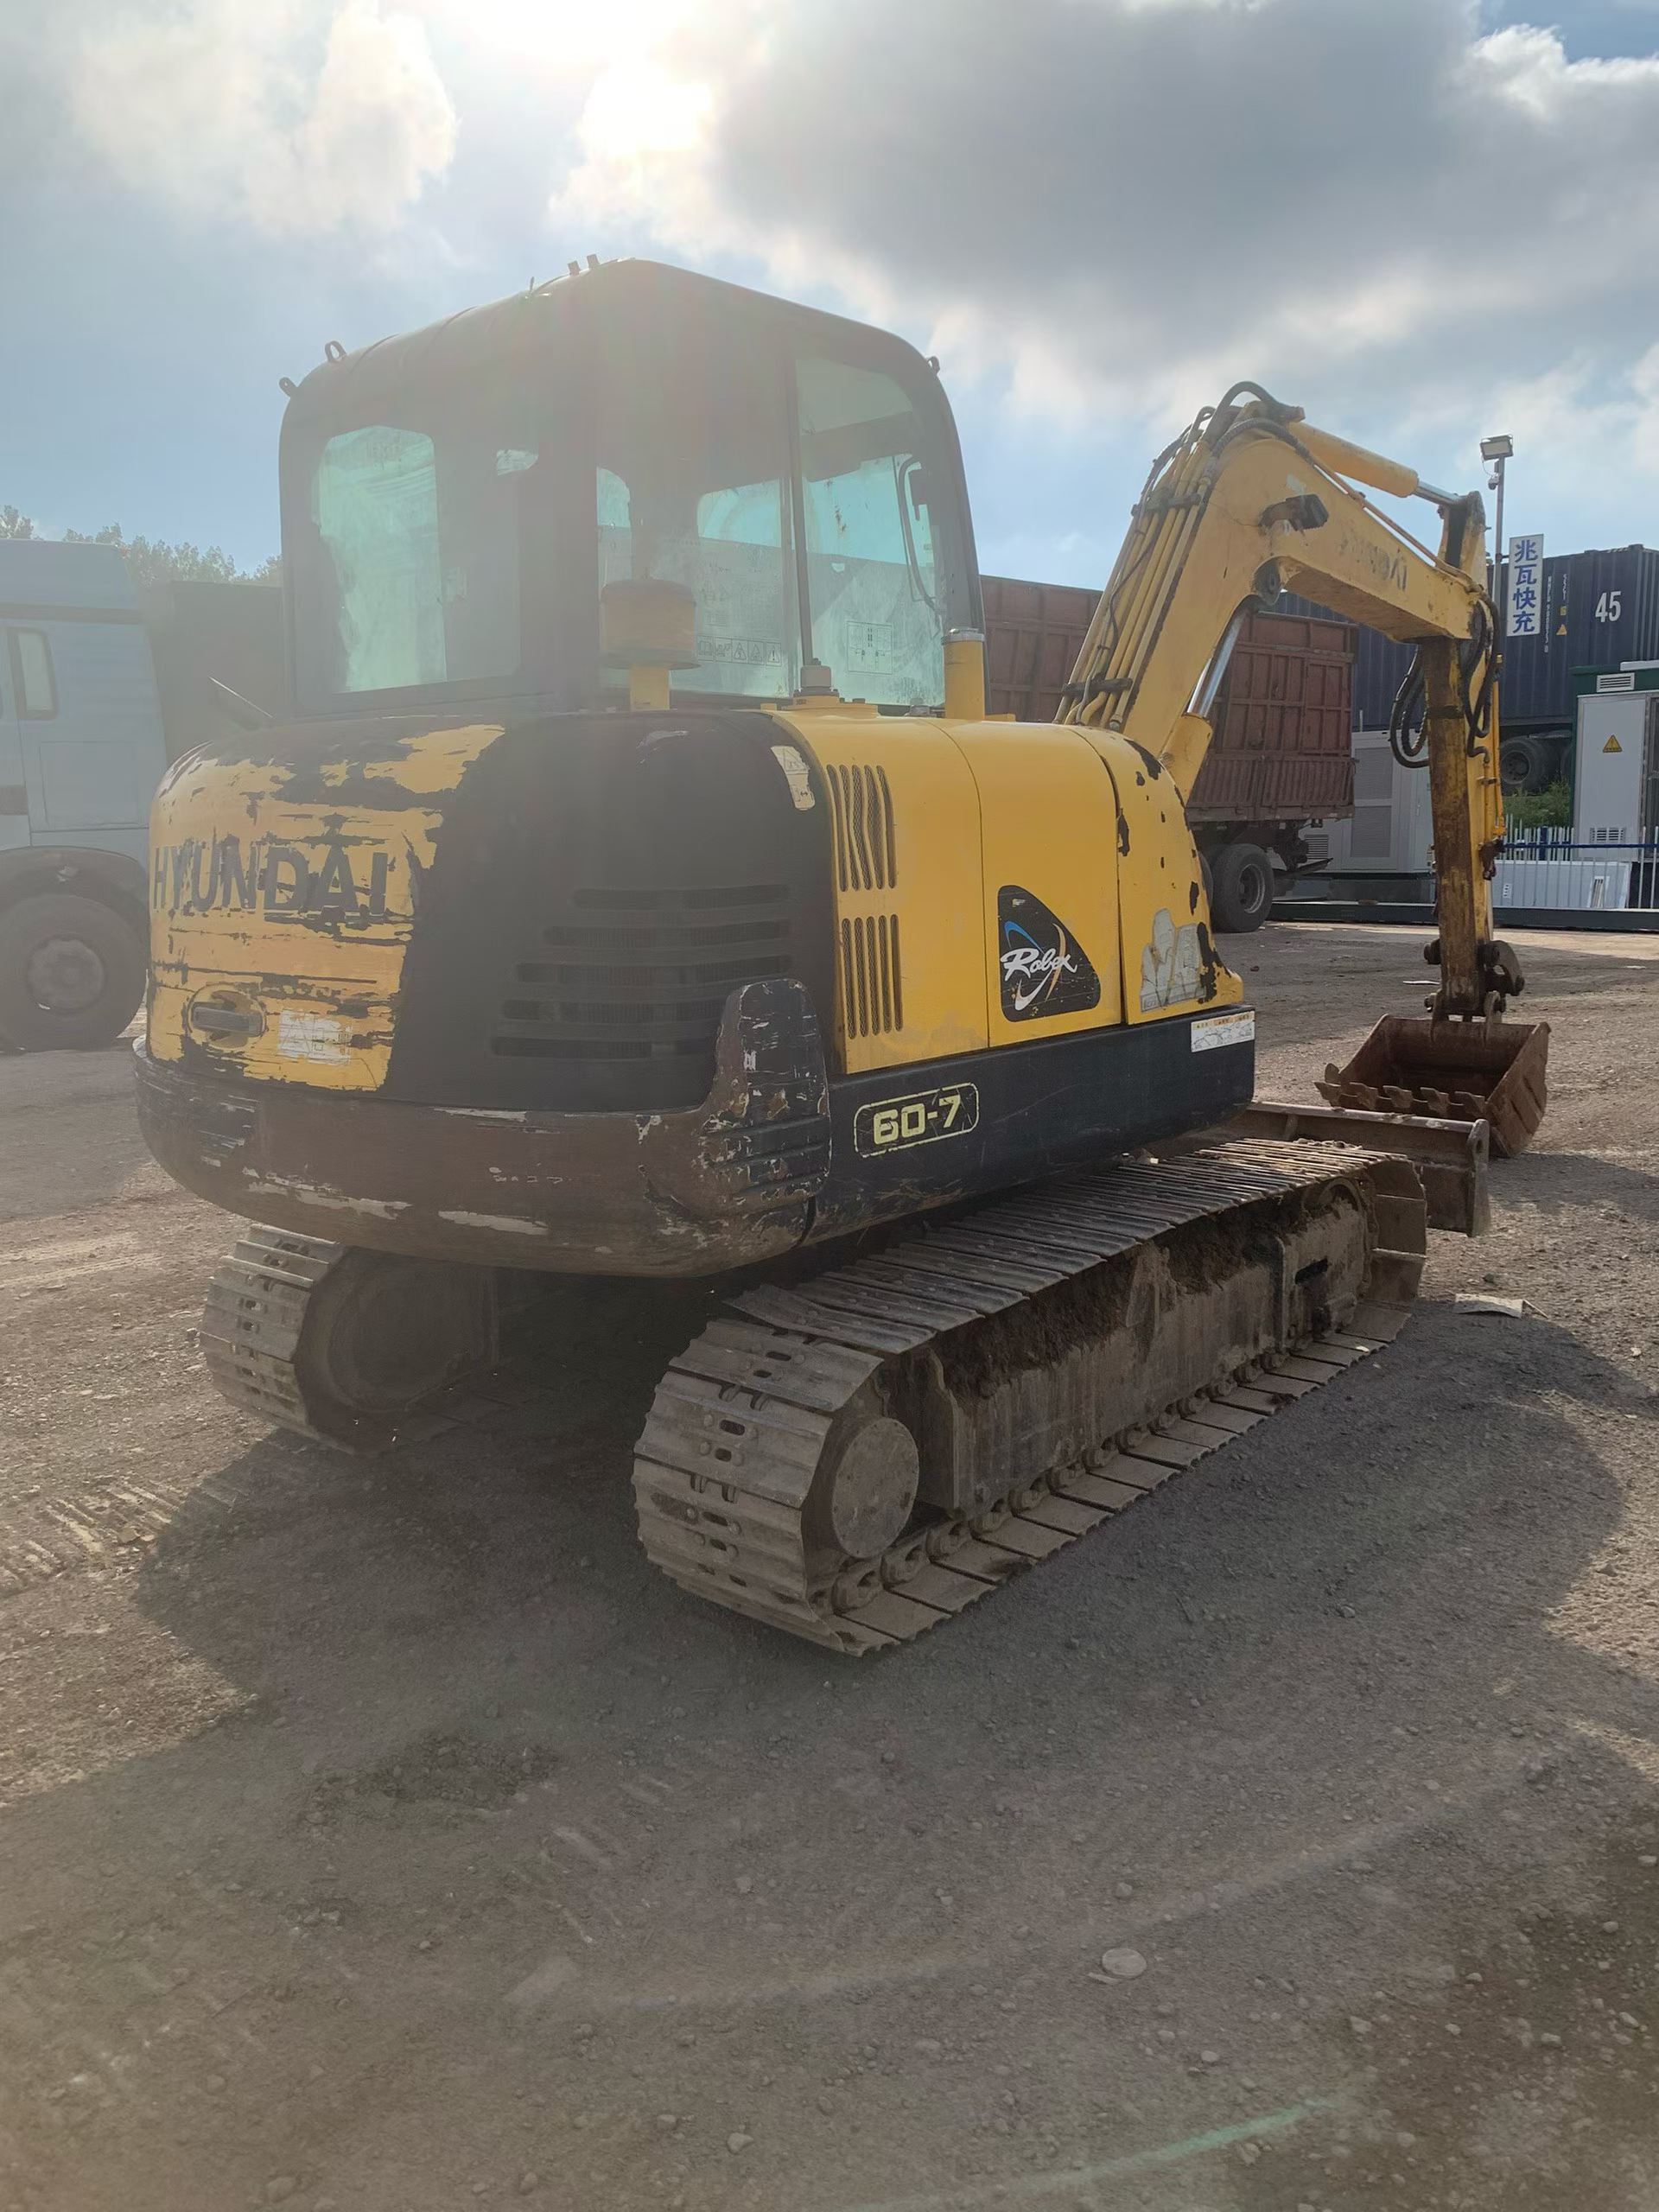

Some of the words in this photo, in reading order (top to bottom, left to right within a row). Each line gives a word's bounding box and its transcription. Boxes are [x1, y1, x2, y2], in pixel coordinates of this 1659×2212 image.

[1512, 539, 1539, 633] 兆瓦快充
[1595, 591, 1622, 623] 45
[153, 841, 389, 916] HYUNDAI
[1000, 947, 1078, 982] Robex
[873, 1095, 961, 1146] 60-7
